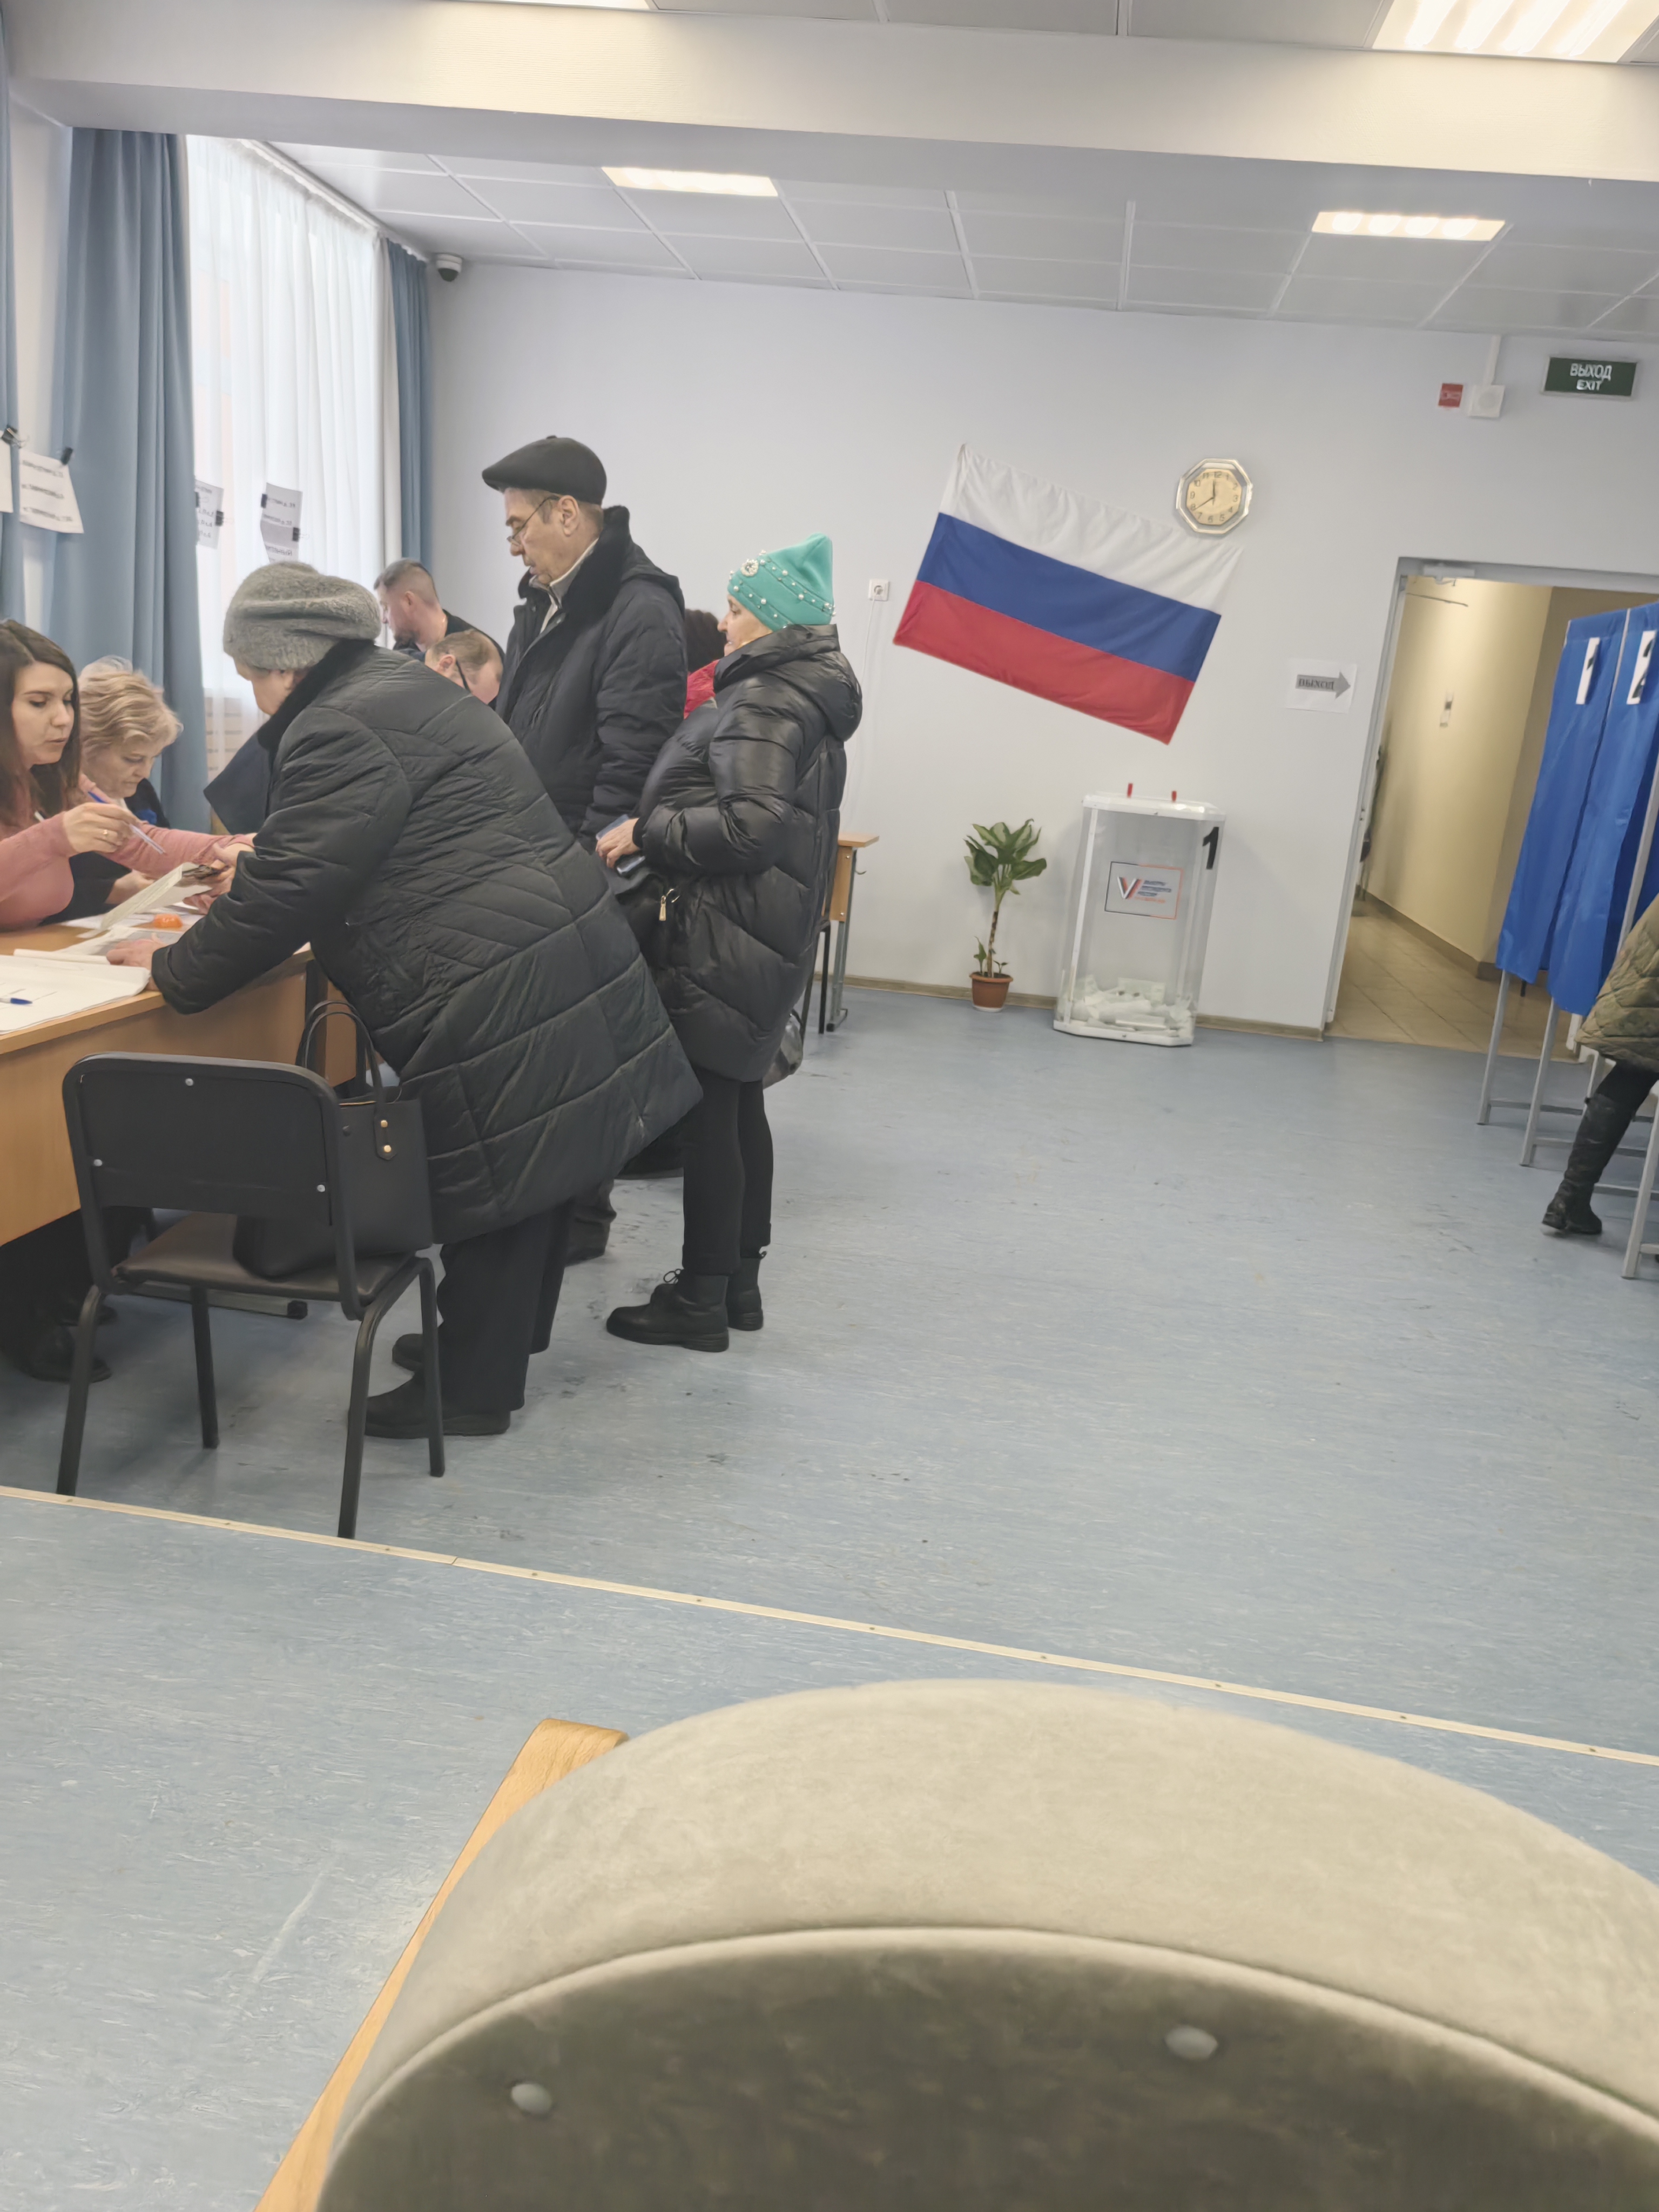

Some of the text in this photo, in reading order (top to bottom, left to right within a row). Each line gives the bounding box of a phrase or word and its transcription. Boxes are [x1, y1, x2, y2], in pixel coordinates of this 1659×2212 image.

[1570, 363, 1612, 381] ВЫХОД
[1576, 379, 1603, 390] EXIT
[1202, 826, 1219, 870] 1
